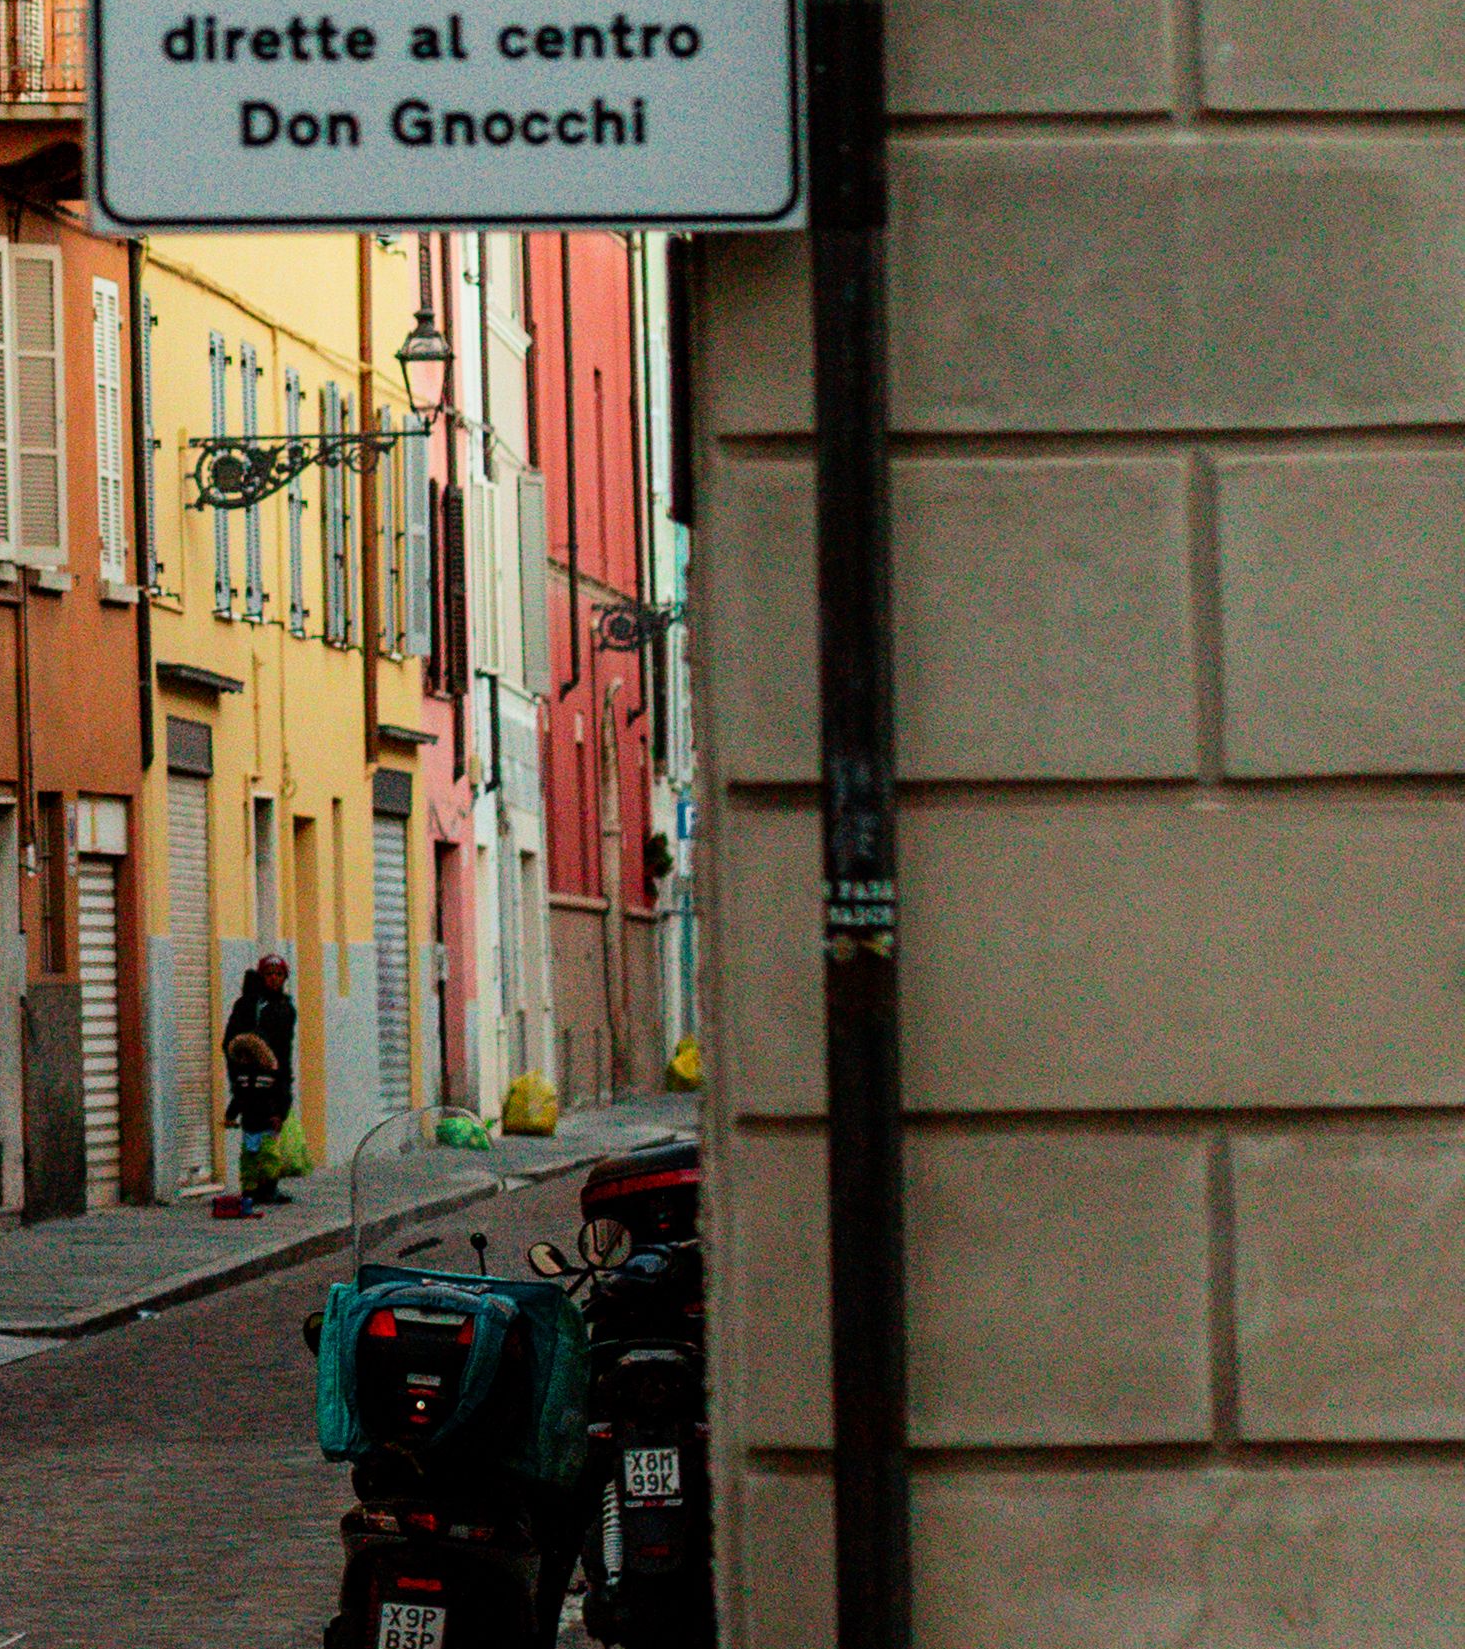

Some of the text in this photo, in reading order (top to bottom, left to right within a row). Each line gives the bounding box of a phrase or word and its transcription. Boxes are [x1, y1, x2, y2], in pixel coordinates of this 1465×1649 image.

[162, 13, 702, 63] dirette al centro
[239, 96, 647, 149] Don Gnocchi
[630, 1451, 674, 1472] X8M
[631, 1472, 673, 1493] 99K
[388, 1603, 437, 1630] X9P
